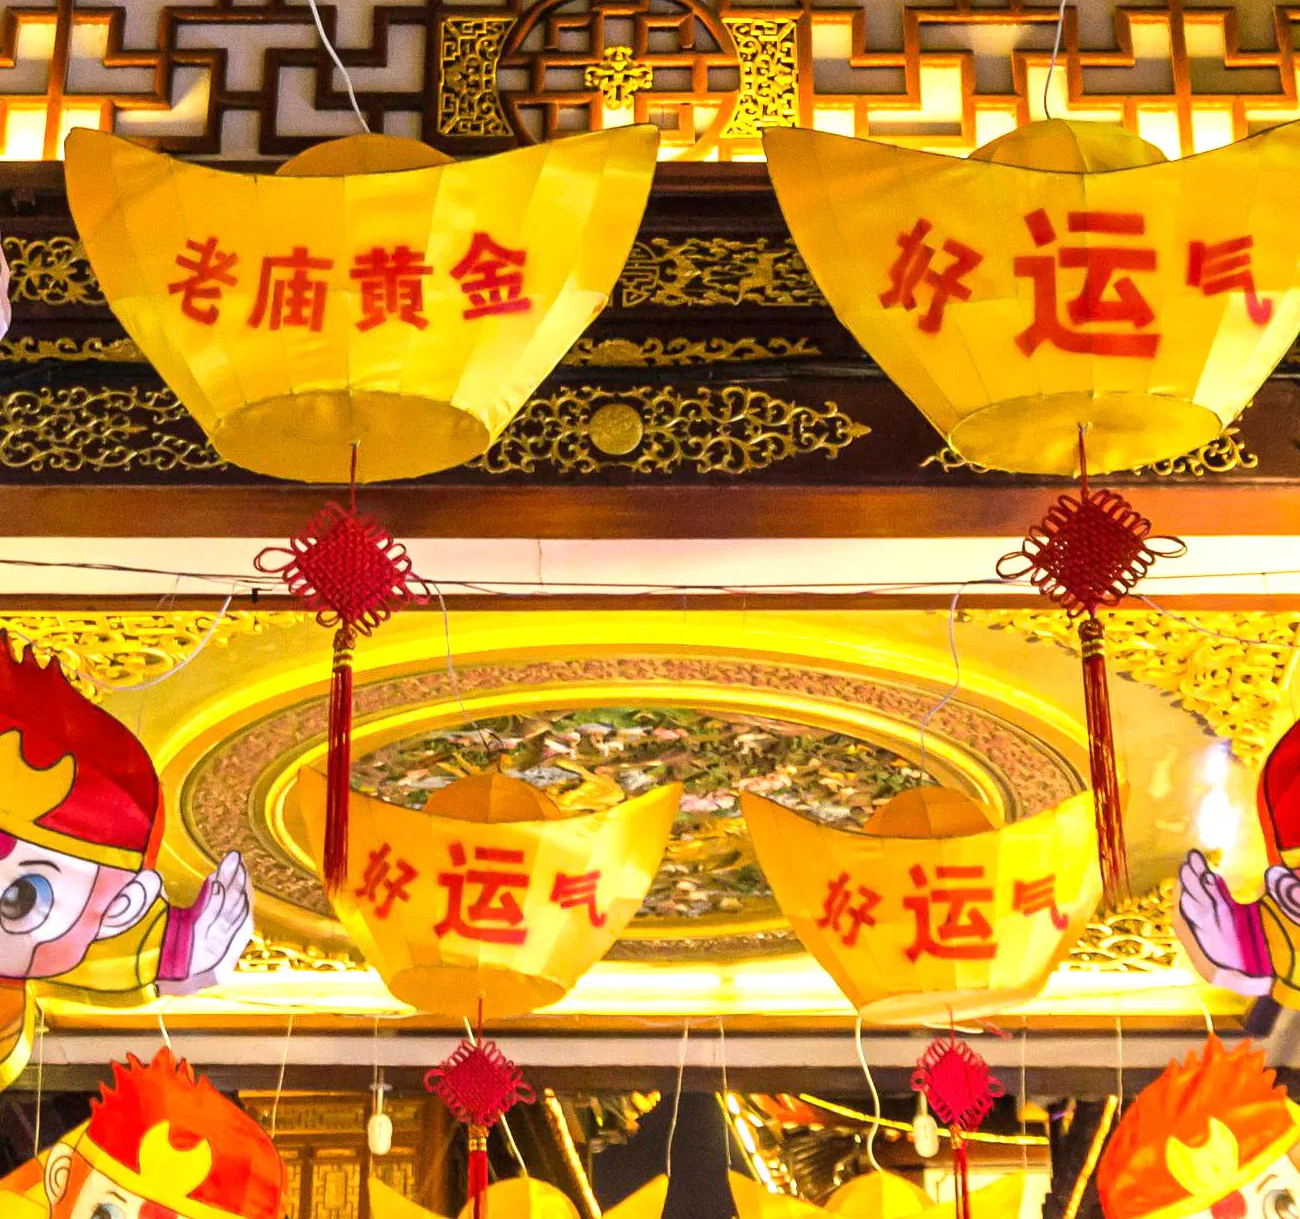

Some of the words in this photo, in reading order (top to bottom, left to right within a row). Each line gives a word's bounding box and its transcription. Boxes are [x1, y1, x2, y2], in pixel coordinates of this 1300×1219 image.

[167, 231, 533, 334] 老庙黄金
[878, 208, 1274, 360] 好运气
[354, 841, 608, 946] 好运气
[816, 864, 1070, 962] 好运气
